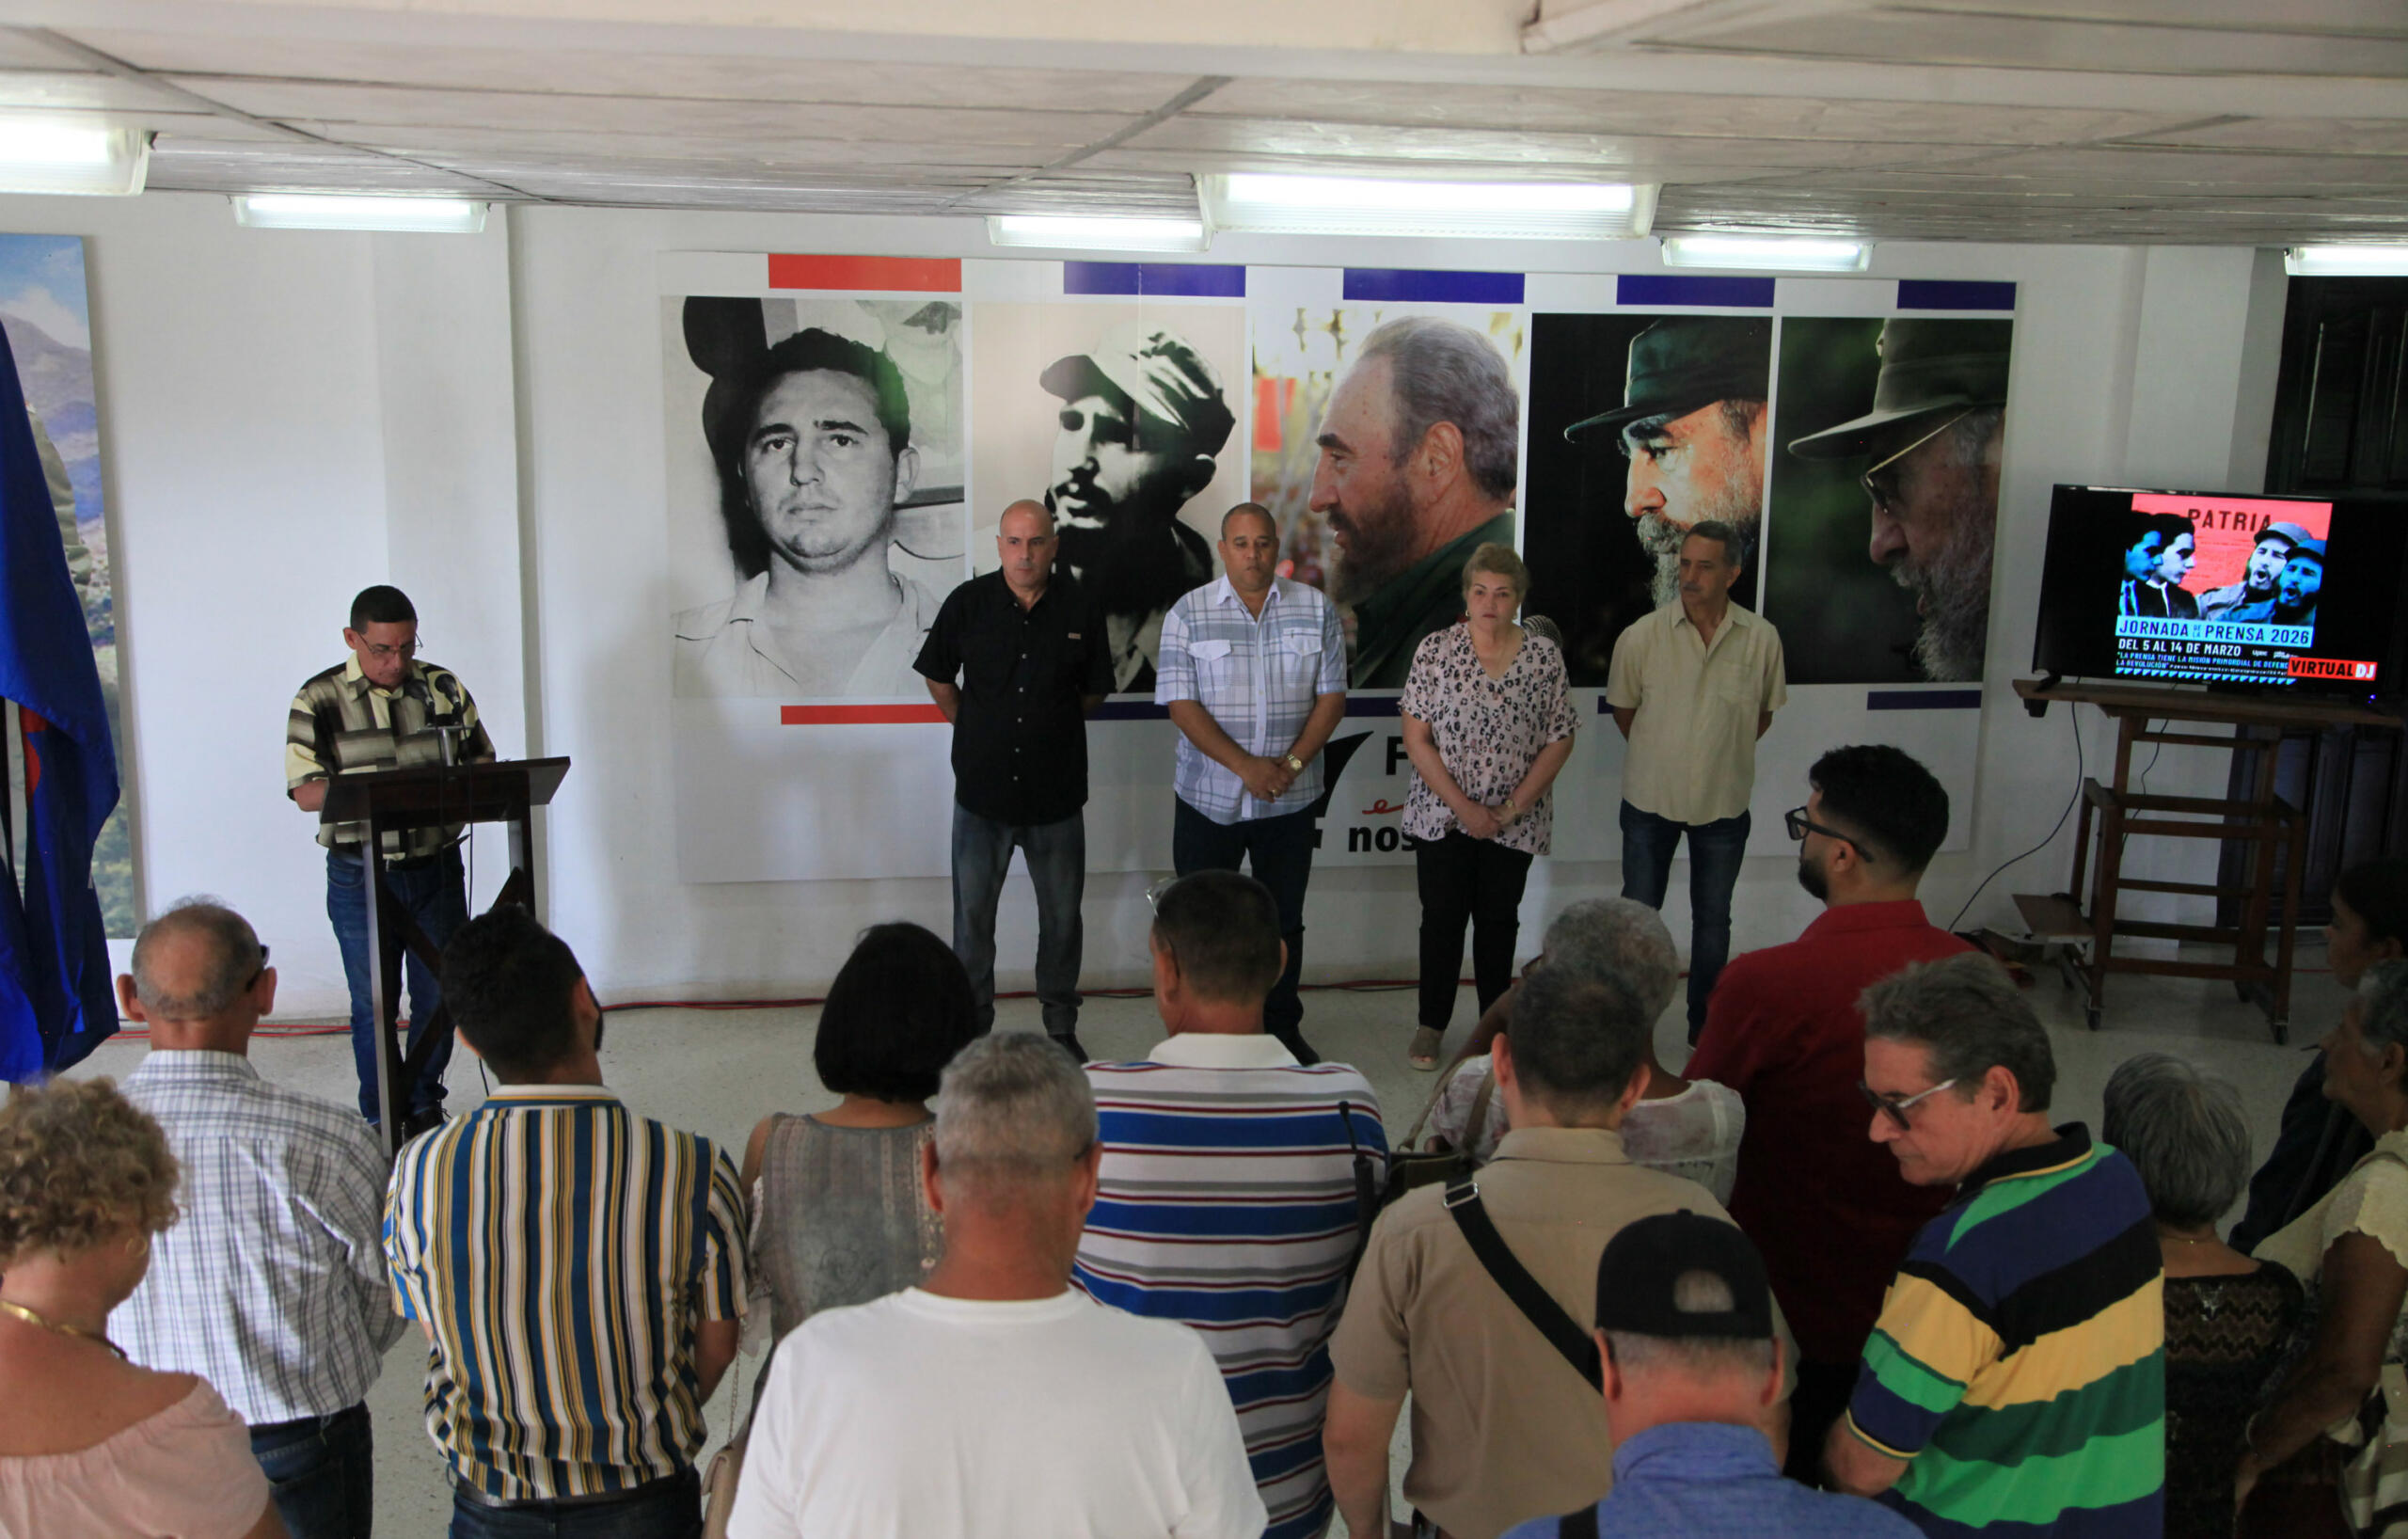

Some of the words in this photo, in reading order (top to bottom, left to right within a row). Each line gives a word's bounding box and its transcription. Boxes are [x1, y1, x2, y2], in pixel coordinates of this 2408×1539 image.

[2188, 508, 2271, 532] PATRIA
[2119, 619, 2189, 637] JORNADA
[2205, 625, 2265, 642] PRENSA
[2271, 628, 2310, 644] 2026
[2118, 638, 2139, 650] DEL
[2143, 640, 2151, 651] 5
[2152, 641, 2167, 652] AL
[2171, 642, 2183, 653] 14
[2186, 643, 2201, 655] DE
[2204, 643, 2242, 657] MARZO
[2130, 652, 2156, 660] PRENSA
[2158, 654, 2177, 662] TIENE
[2212, 658, 2251, 667] PRIMORDIAL
